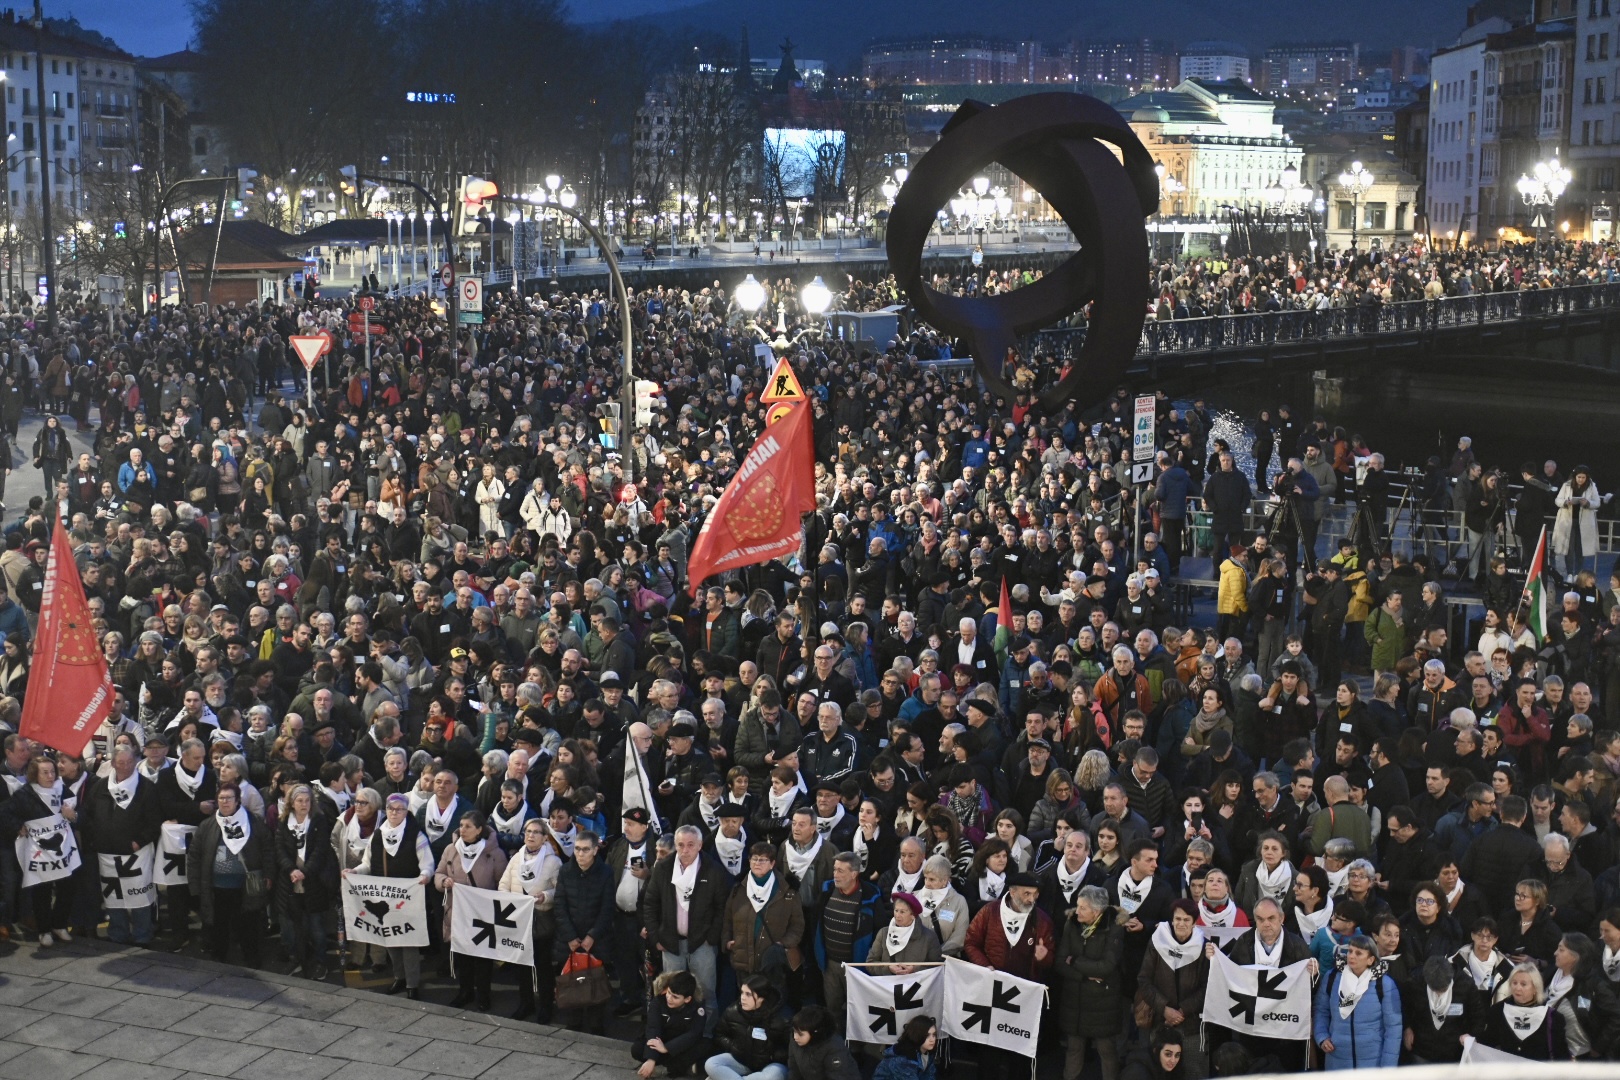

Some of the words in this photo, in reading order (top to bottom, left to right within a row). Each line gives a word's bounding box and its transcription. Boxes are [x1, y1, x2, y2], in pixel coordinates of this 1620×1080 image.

[127, 882, 154, 896] etxera
[361, 890, 411, 901] IHESLARIAK
[354, 916, 416, 938] ETXERA
[501, 937, 525, 951] etxera
[1261, 1011, 1300, 1023] etxera
[996, 1023, 1031, 1039] etxera
